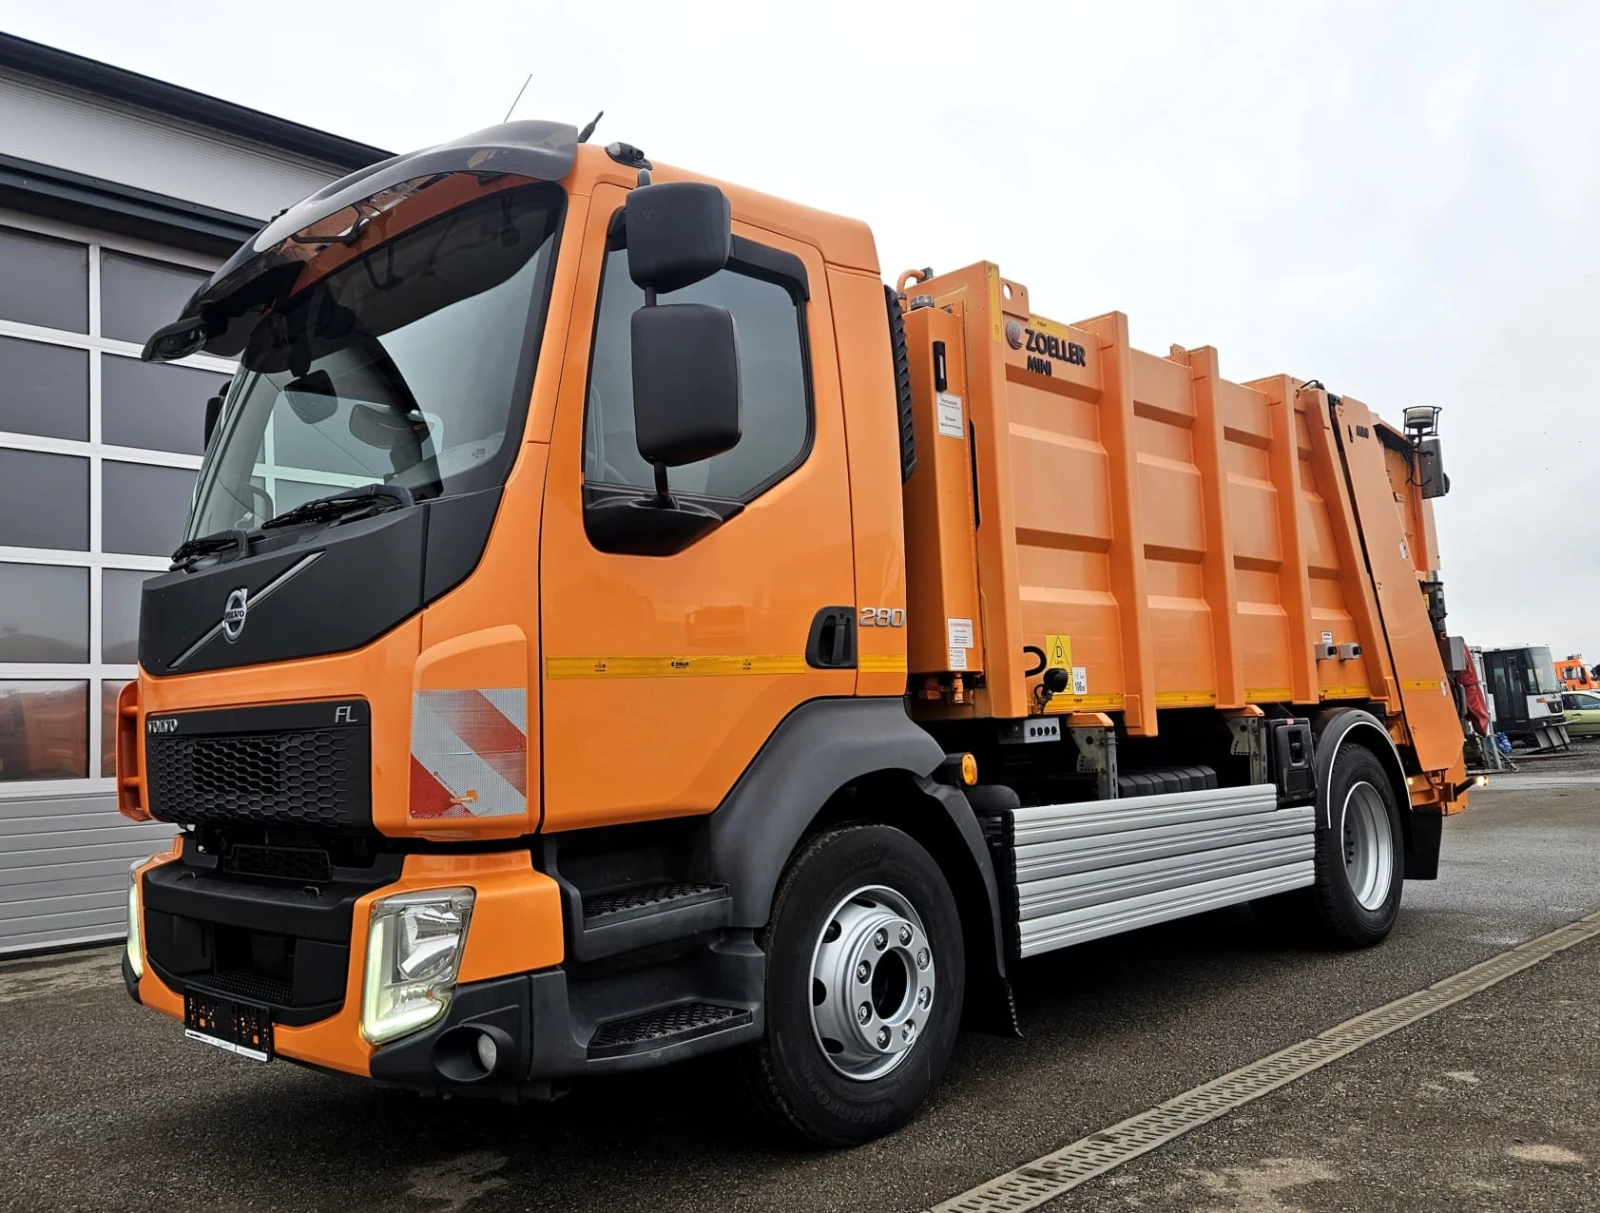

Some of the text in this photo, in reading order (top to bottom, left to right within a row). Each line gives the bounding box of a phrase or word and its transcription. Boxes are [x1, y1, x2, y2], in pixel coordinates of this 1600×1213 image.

[1025, 328, 1086, 367] ZOELLER
[1027, 355, 1052, 376] MINI
[860, 607, 905, 627] 280
[335, 705, 358, 723] FL
[147, 719, 178, 733] VOLVO
